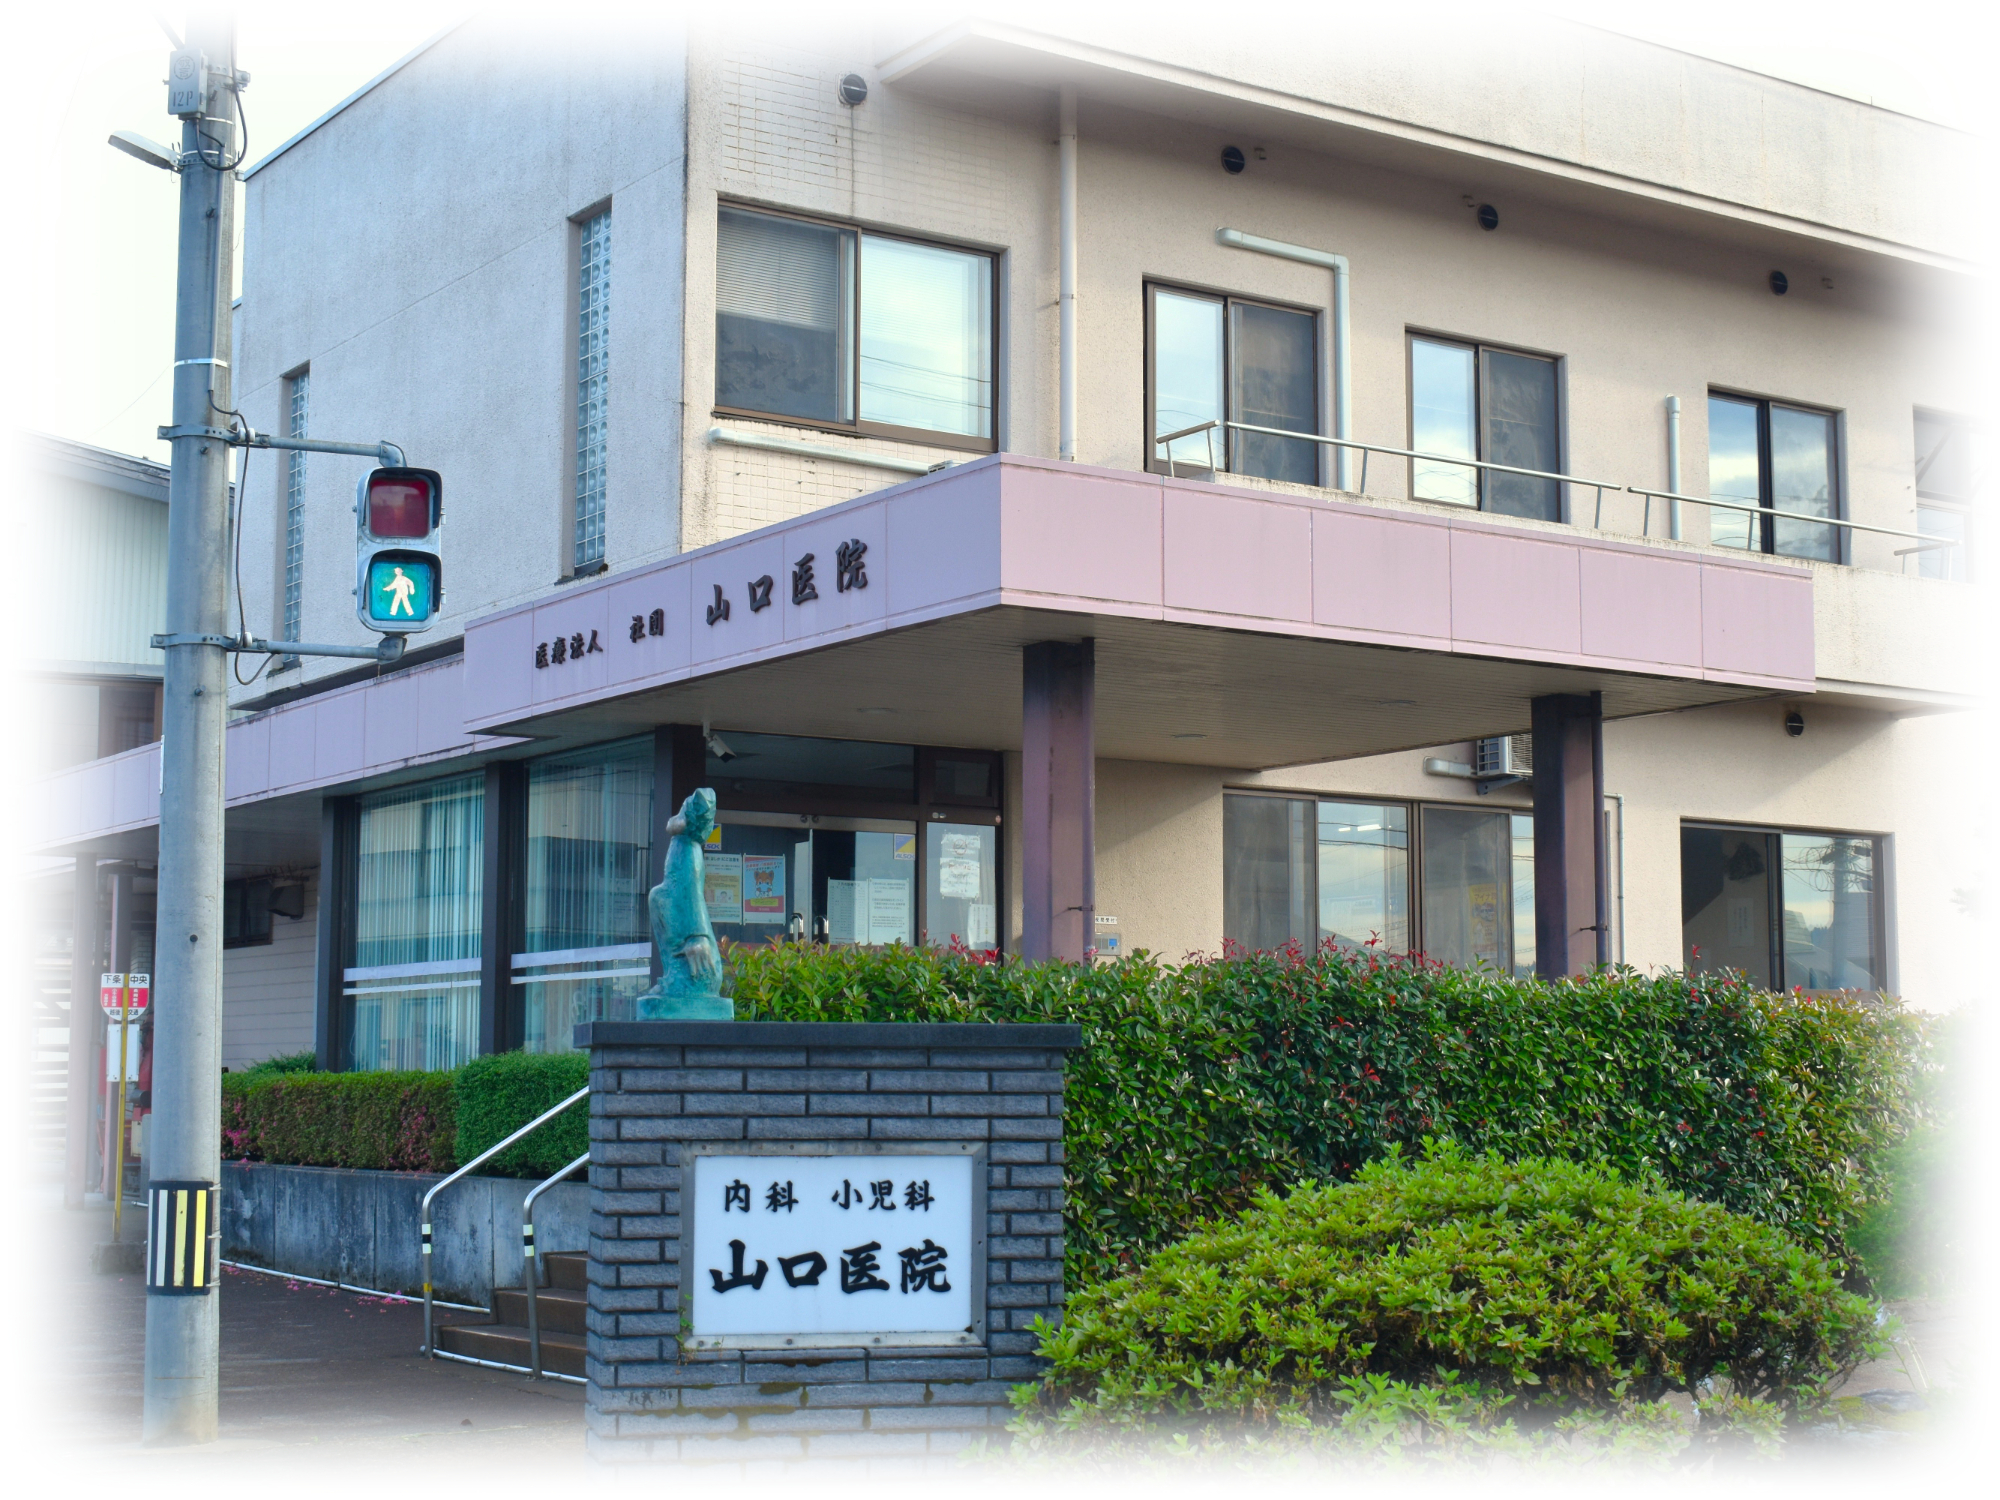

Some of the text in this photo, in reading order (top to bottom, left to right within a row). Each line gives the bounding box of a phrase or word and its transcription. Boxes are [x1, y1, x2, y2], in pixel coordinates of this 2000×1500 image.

[172, 91, 193, 107] 12P
[535, 538, 868, 669] 医療法人 社団 山口医院
[724, 1179, 935, 1213] 内科 小児科
[709, 1239, 952, 1294] 山口医院
